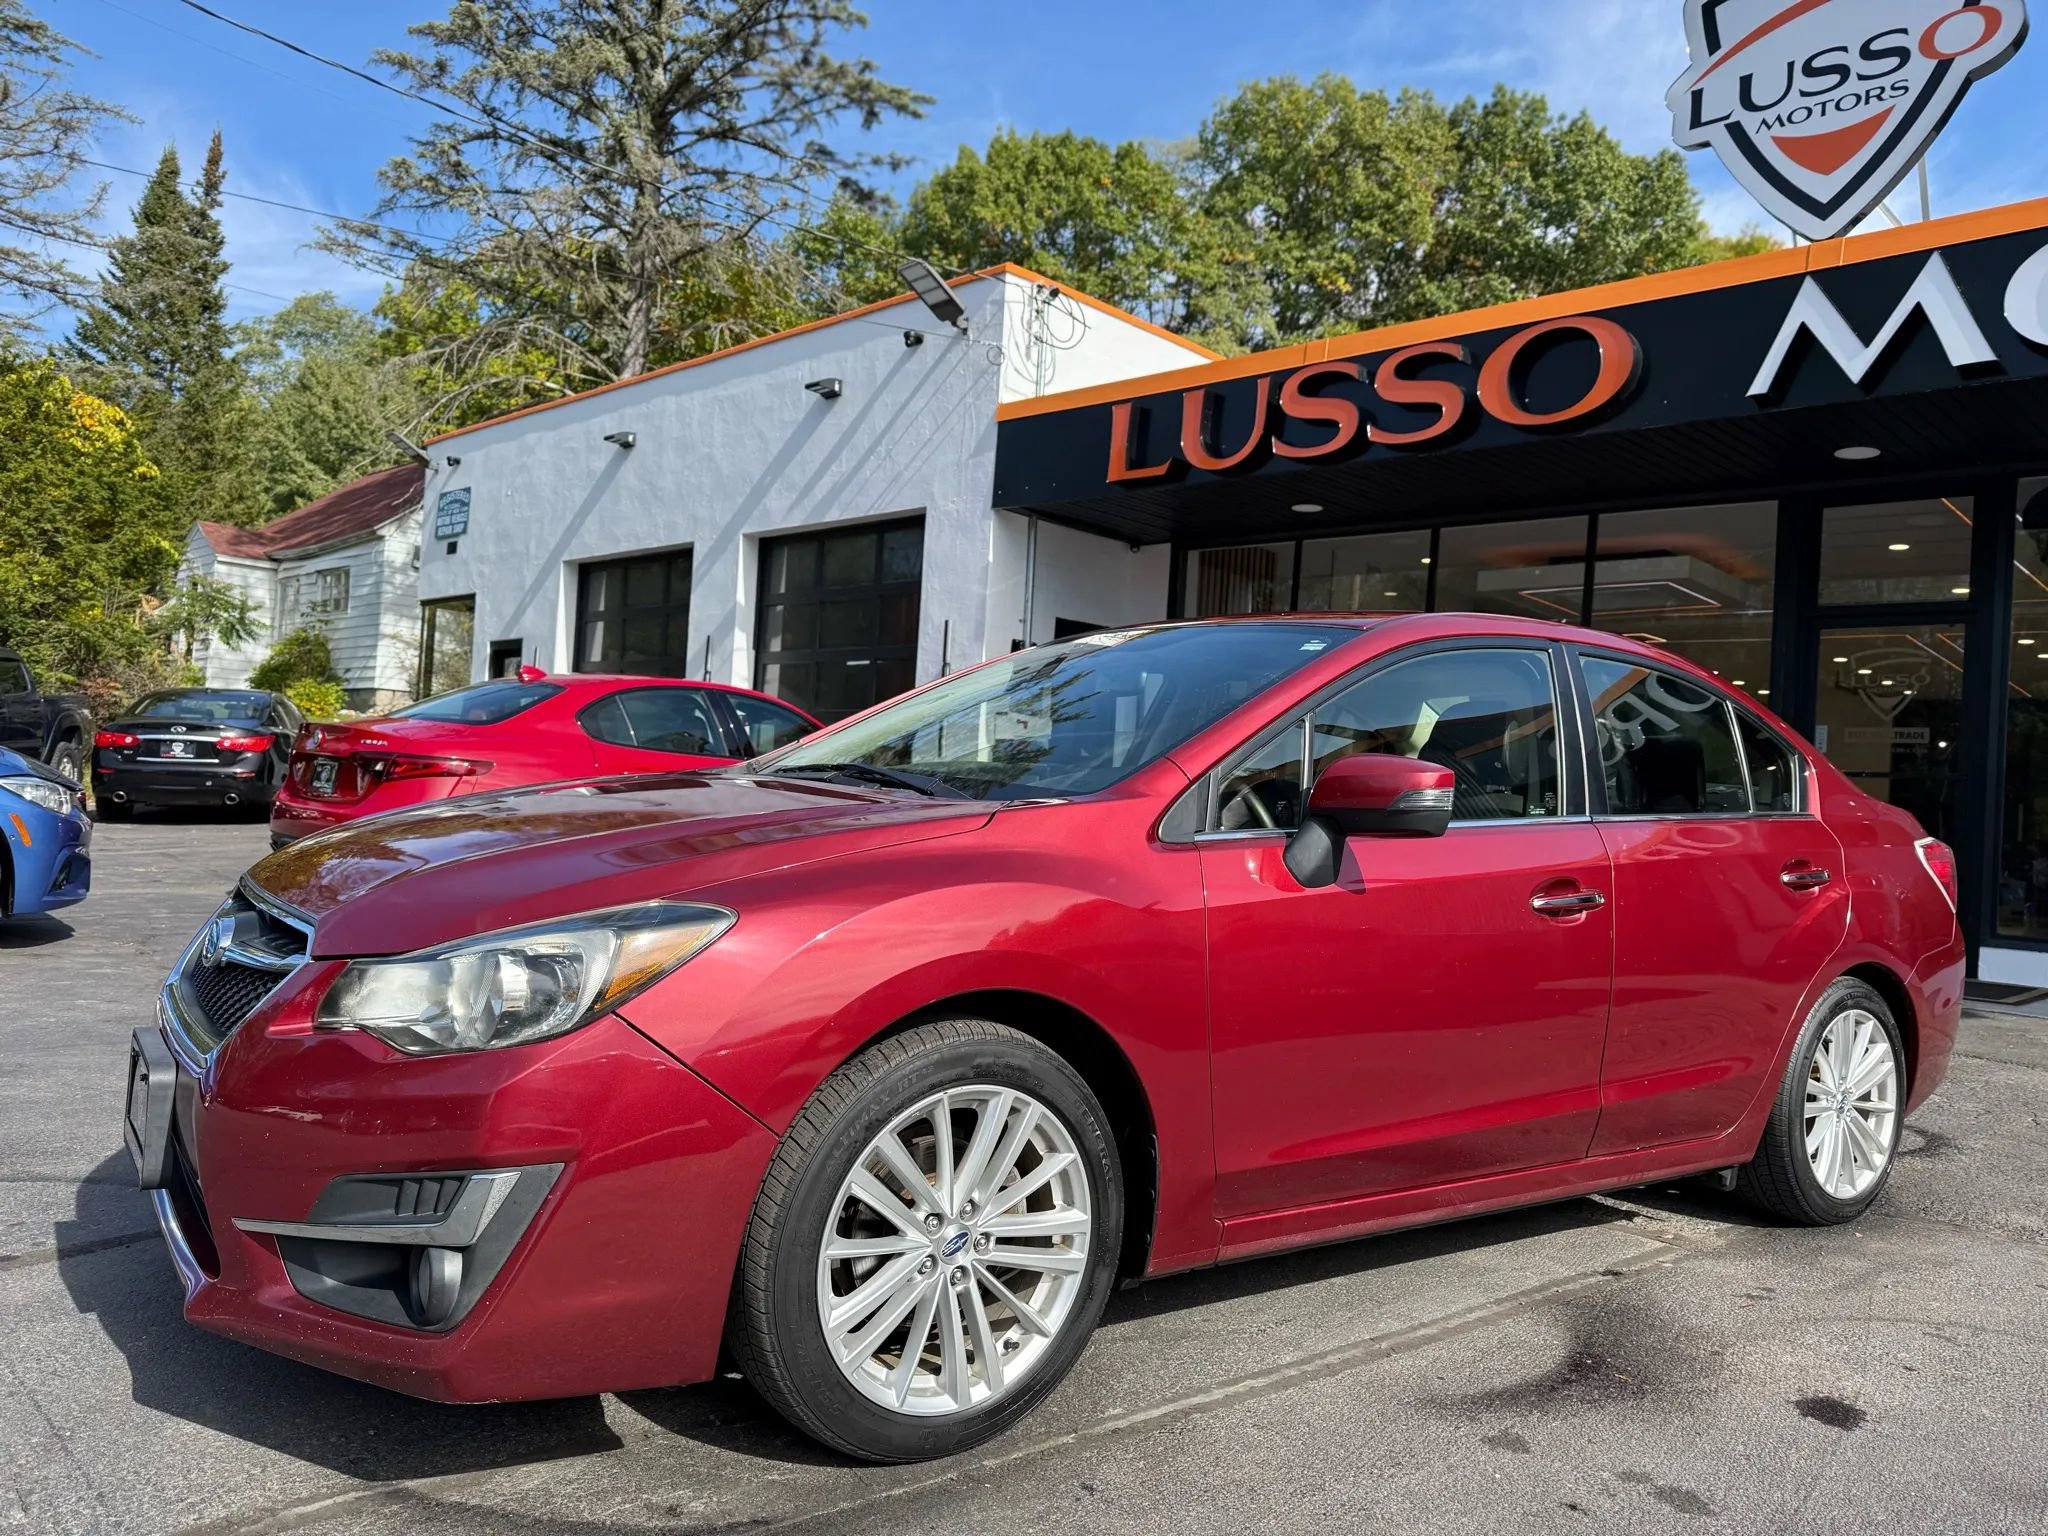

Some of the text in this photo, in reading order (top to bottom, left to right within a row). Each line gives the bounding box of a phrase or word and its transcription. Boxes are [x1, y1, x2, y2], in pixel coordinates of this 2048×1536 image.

[1689, 5, 2003, 130] LUSSO
[1755, 79, 1910, 135] MOTORS
[1106, 245, 2048, 483] LUSSO M
